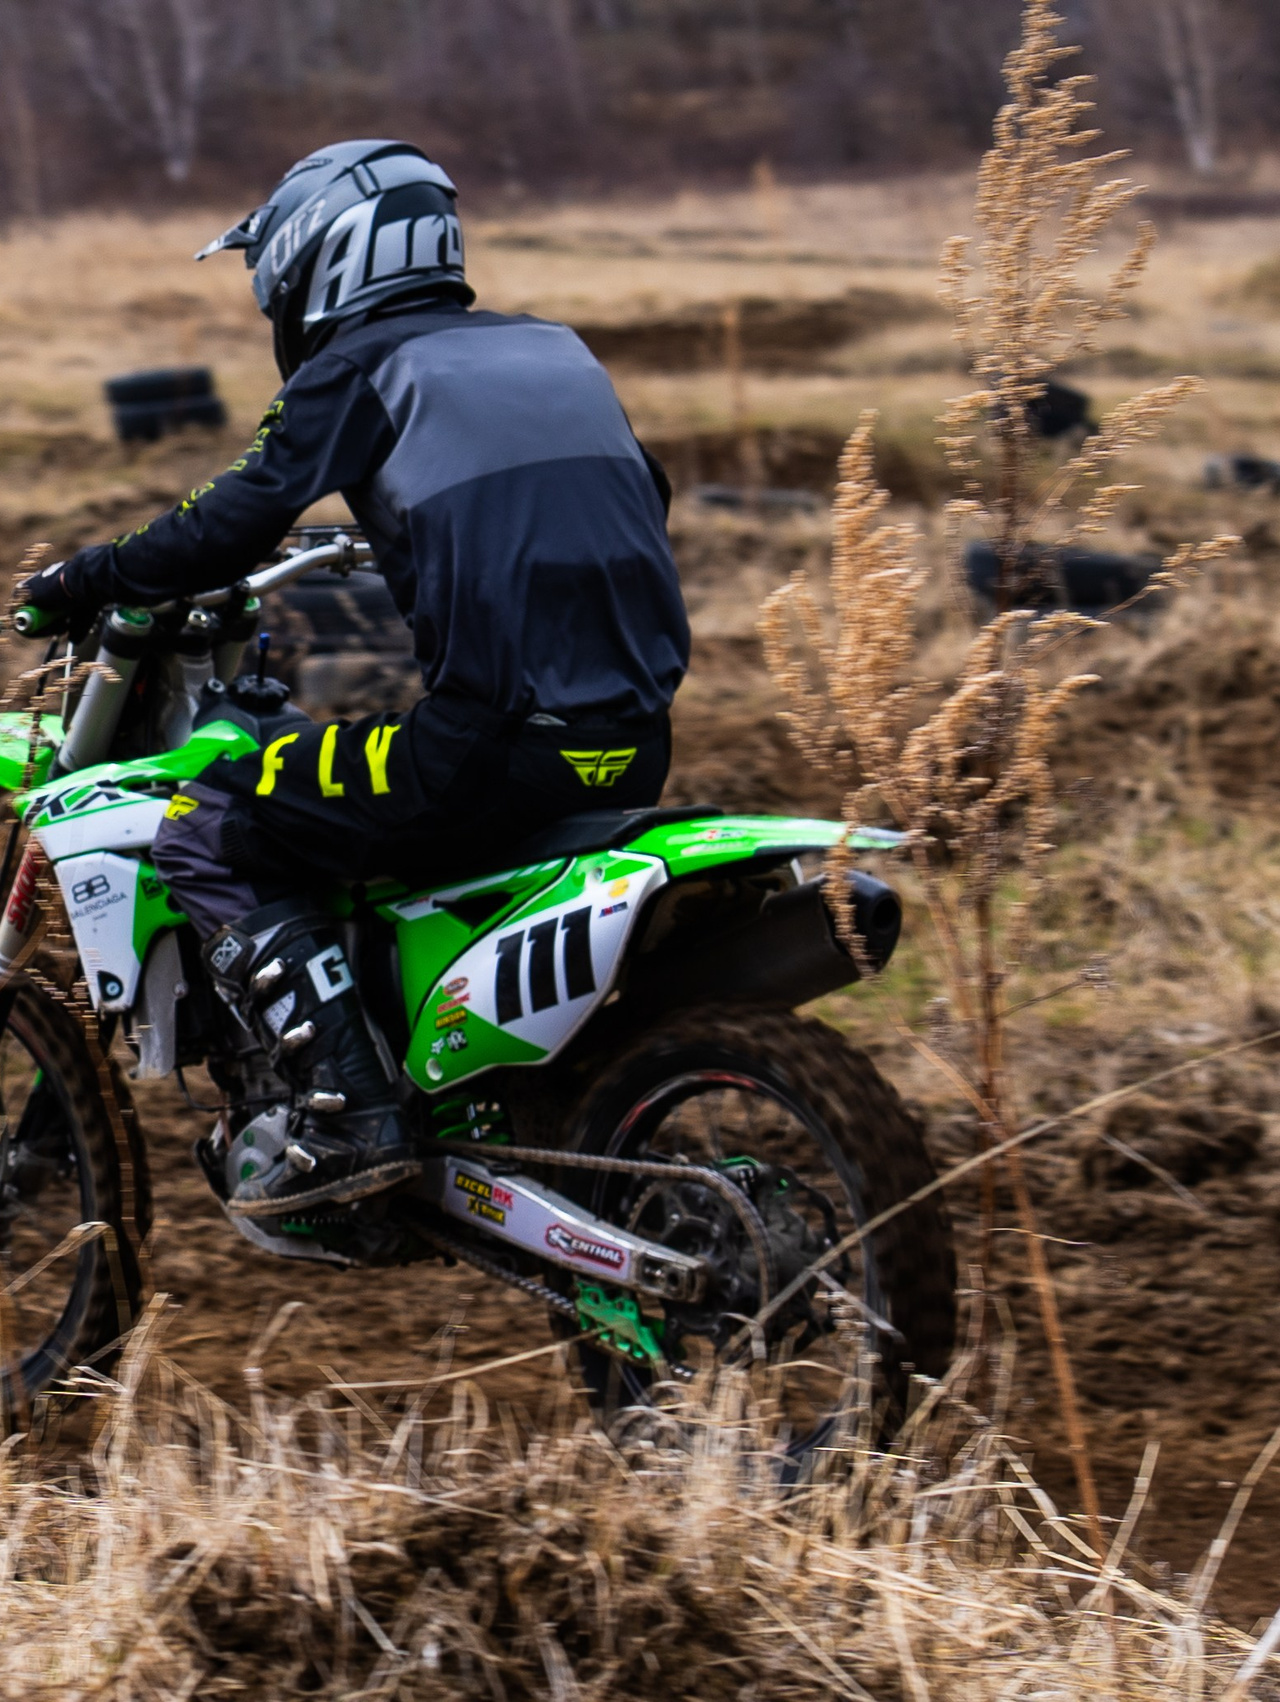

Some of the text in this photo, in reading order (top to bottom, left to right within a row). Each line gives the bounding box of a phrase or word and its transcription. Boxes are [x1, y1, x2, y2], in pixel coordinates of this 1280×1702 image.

[256, 724, 401, 796] FLY
[306, 944, 355, 1002] G
[495, 905, 596, 1026] 111
